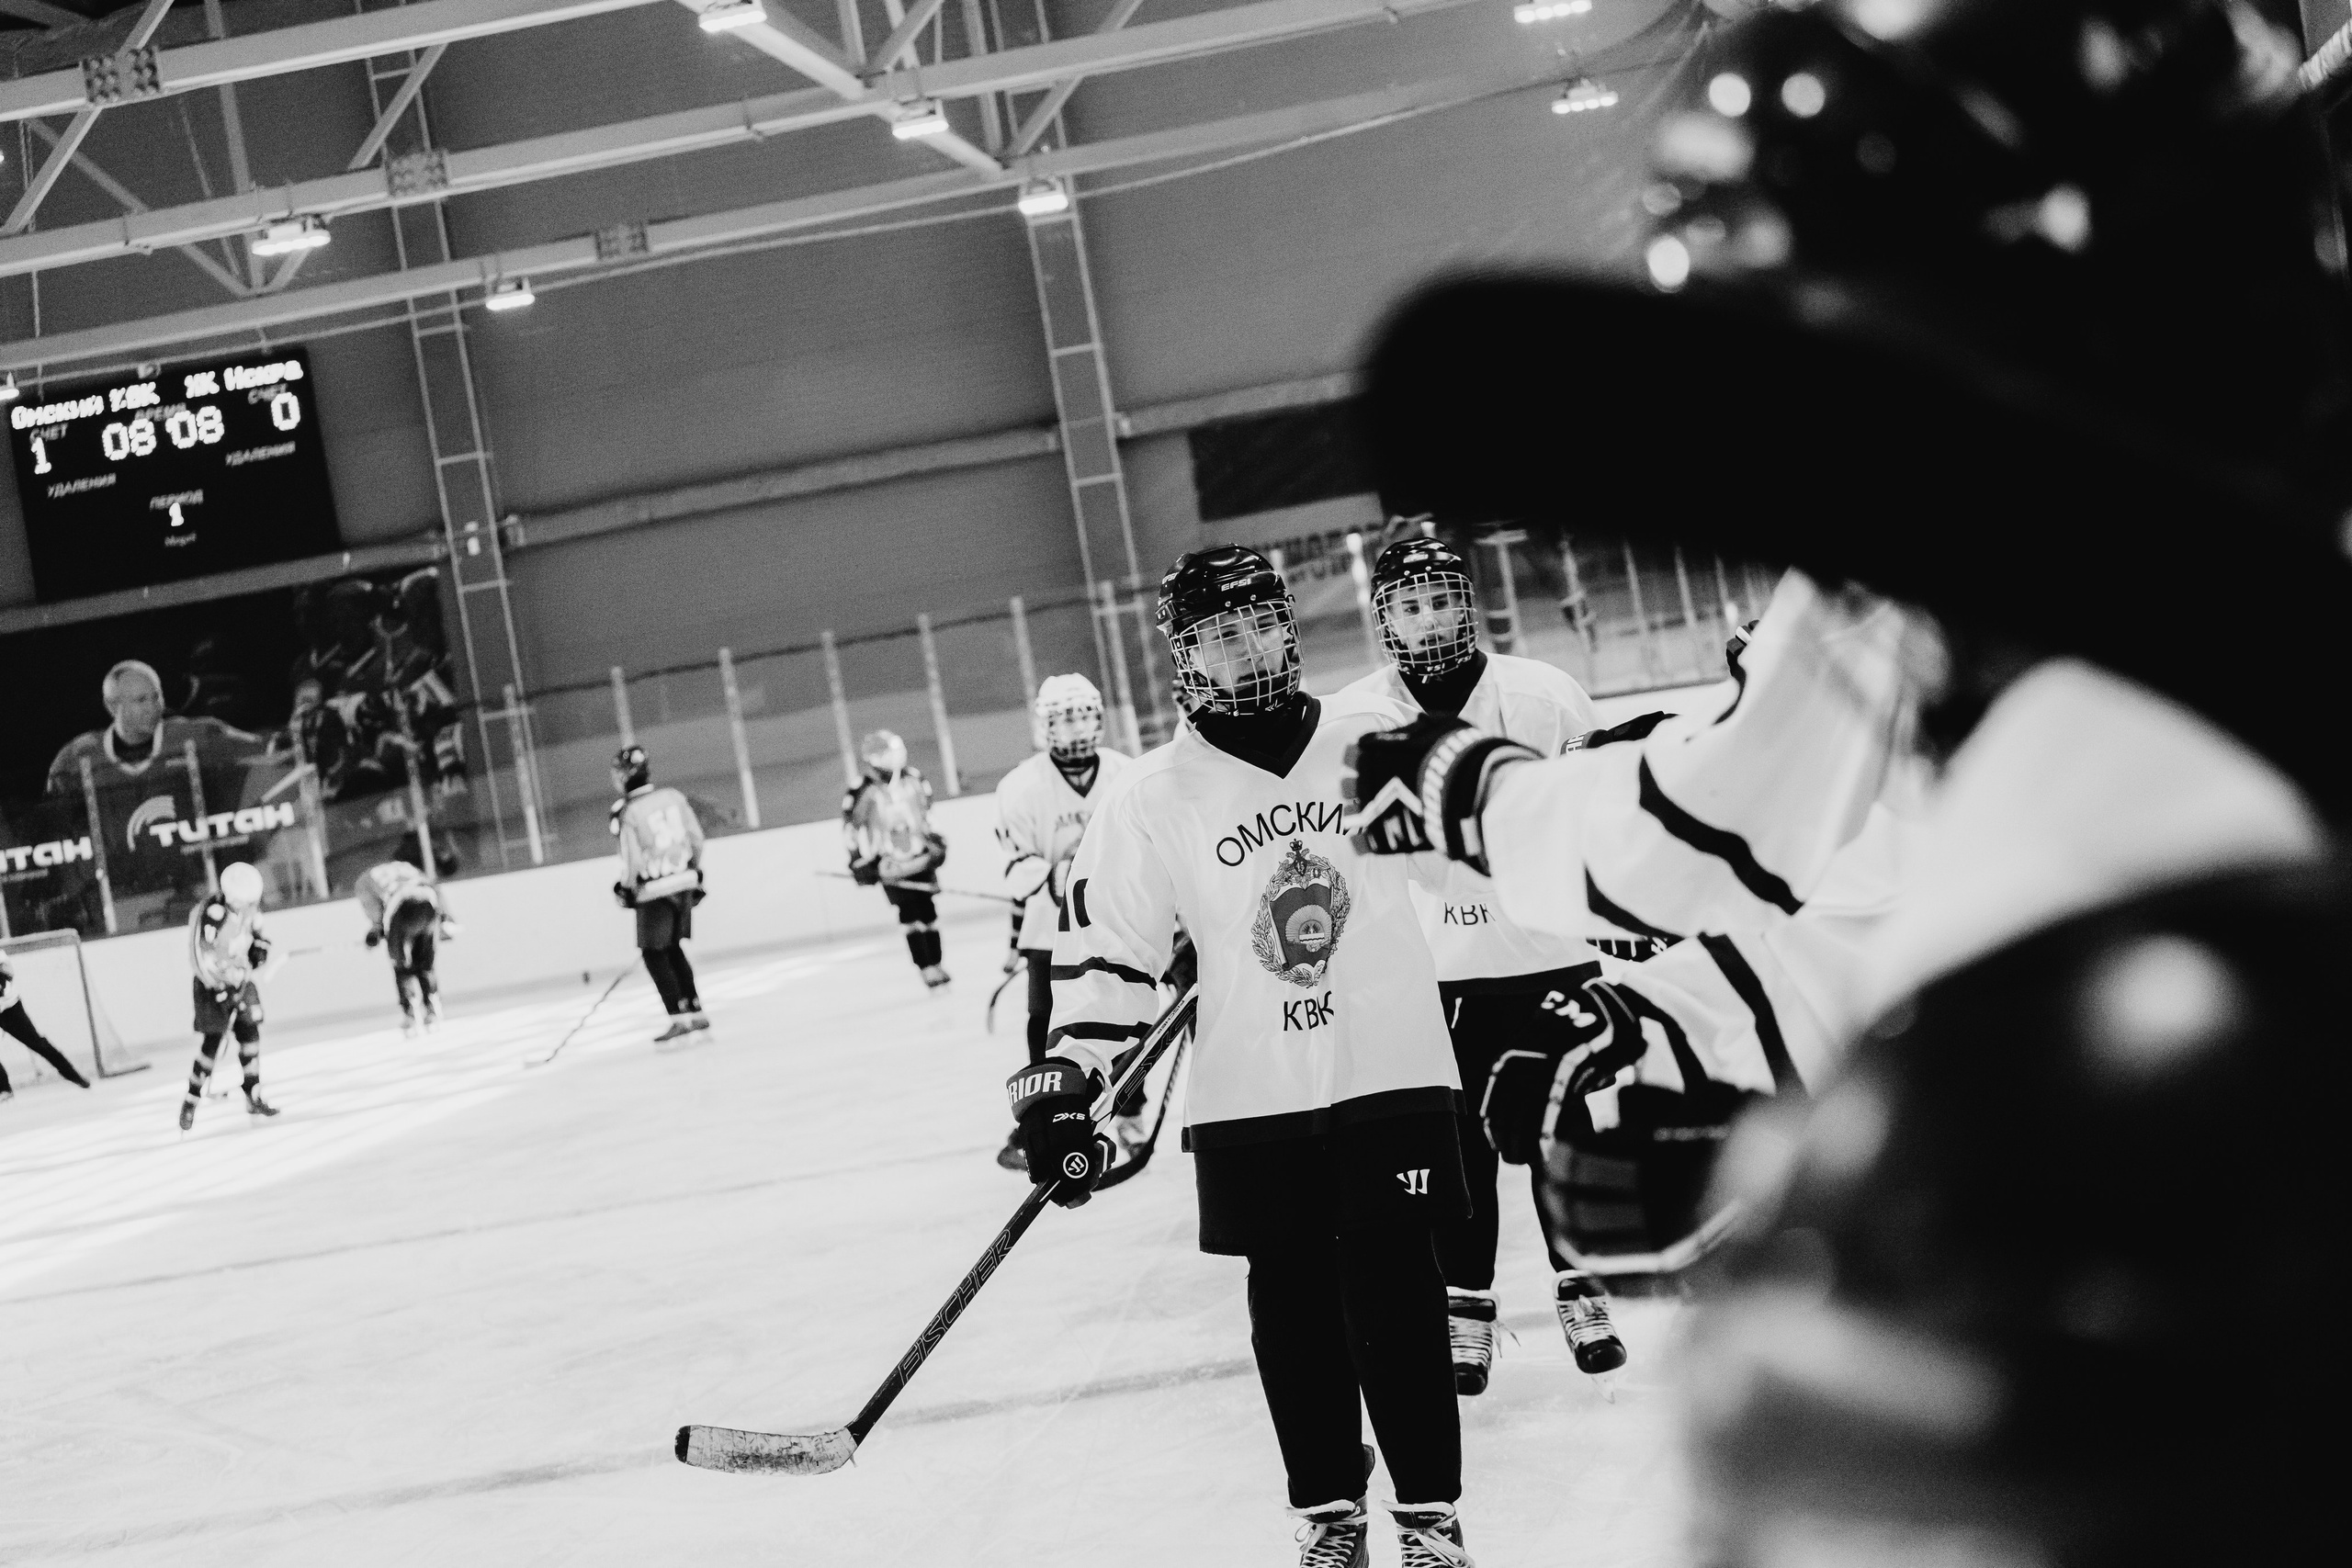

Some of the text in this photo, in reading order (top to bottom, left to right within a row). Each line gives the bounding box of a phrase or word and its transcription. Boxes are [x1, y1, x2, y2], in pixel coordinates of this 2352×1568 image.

[270, 391, 301, 432] 0
[30, 436, 51, 475] 1
[168, 502, 185, 527] 1
[1216, 801, 1362, 867] ОМСКИ
[1283, 990, 1334, 1032] КВК
[898, 1228, 1012, 1385] FISCHER
